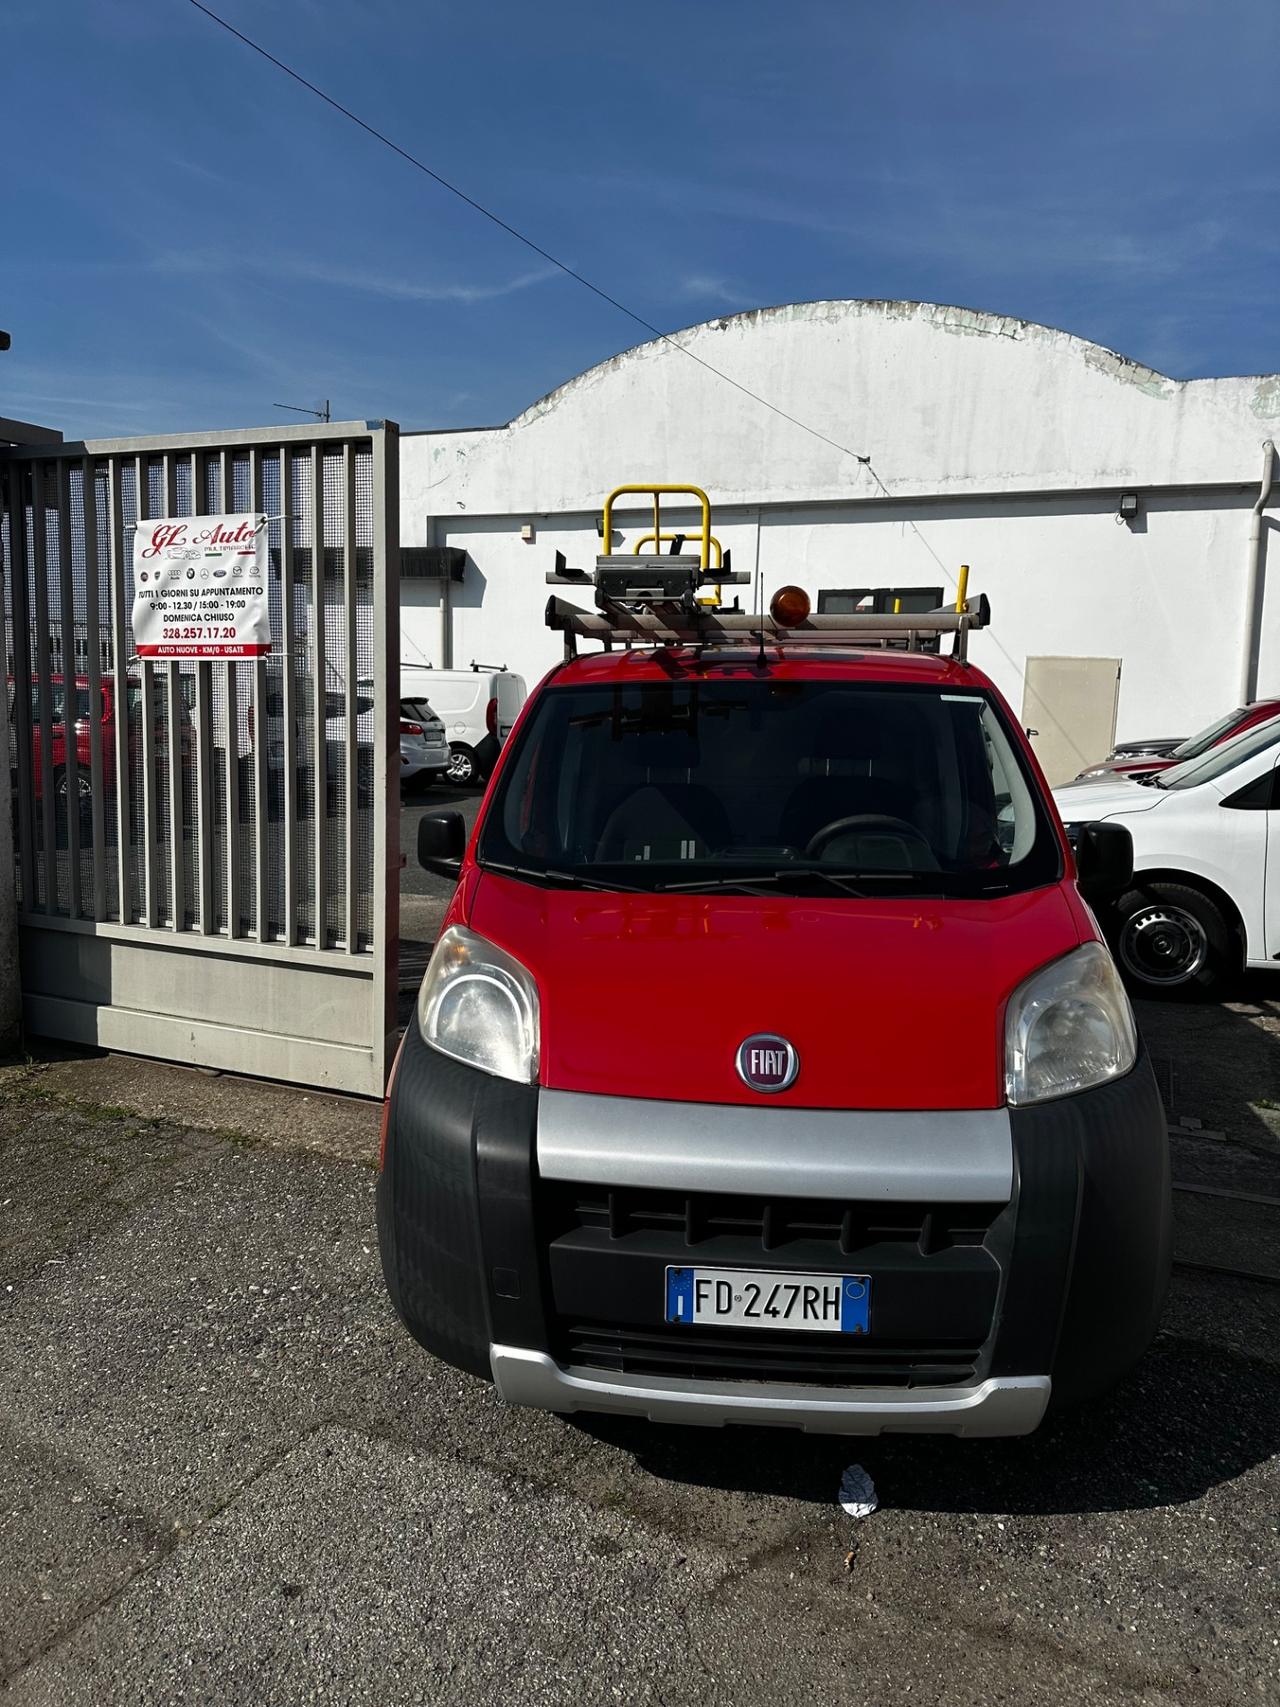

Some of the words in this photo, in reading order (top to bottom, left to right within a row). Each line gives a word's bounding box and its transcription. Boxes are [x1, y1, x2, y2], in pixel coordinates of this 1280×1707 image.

[141, 523, 188, 559] GL
[192, 521, 256, 545] Auto
[160, 589, 188, 598] GIORNI
[189, 589, 200, 598] SU
[201, 586, 264, 597] APPUNTAMENTO
[149, 602, 167, 611] 9:00
[173, 601, 192, 610] 12.30
[199, 601, 219, 609] 15:00
[225, 600, 245, 609] 19:00
[163, 613, 203, 623] DOMENICA
[204, 613, 235, 622] CHIUSO
[162, 627, 236, 639] 328.257.17.20
[157, 646, 175, 654] AUTO
[176, 646, 198, 654] NUOVE
[224, 645, 244, 653] USATE
[751, 1049, 786, 1076] FIAT
